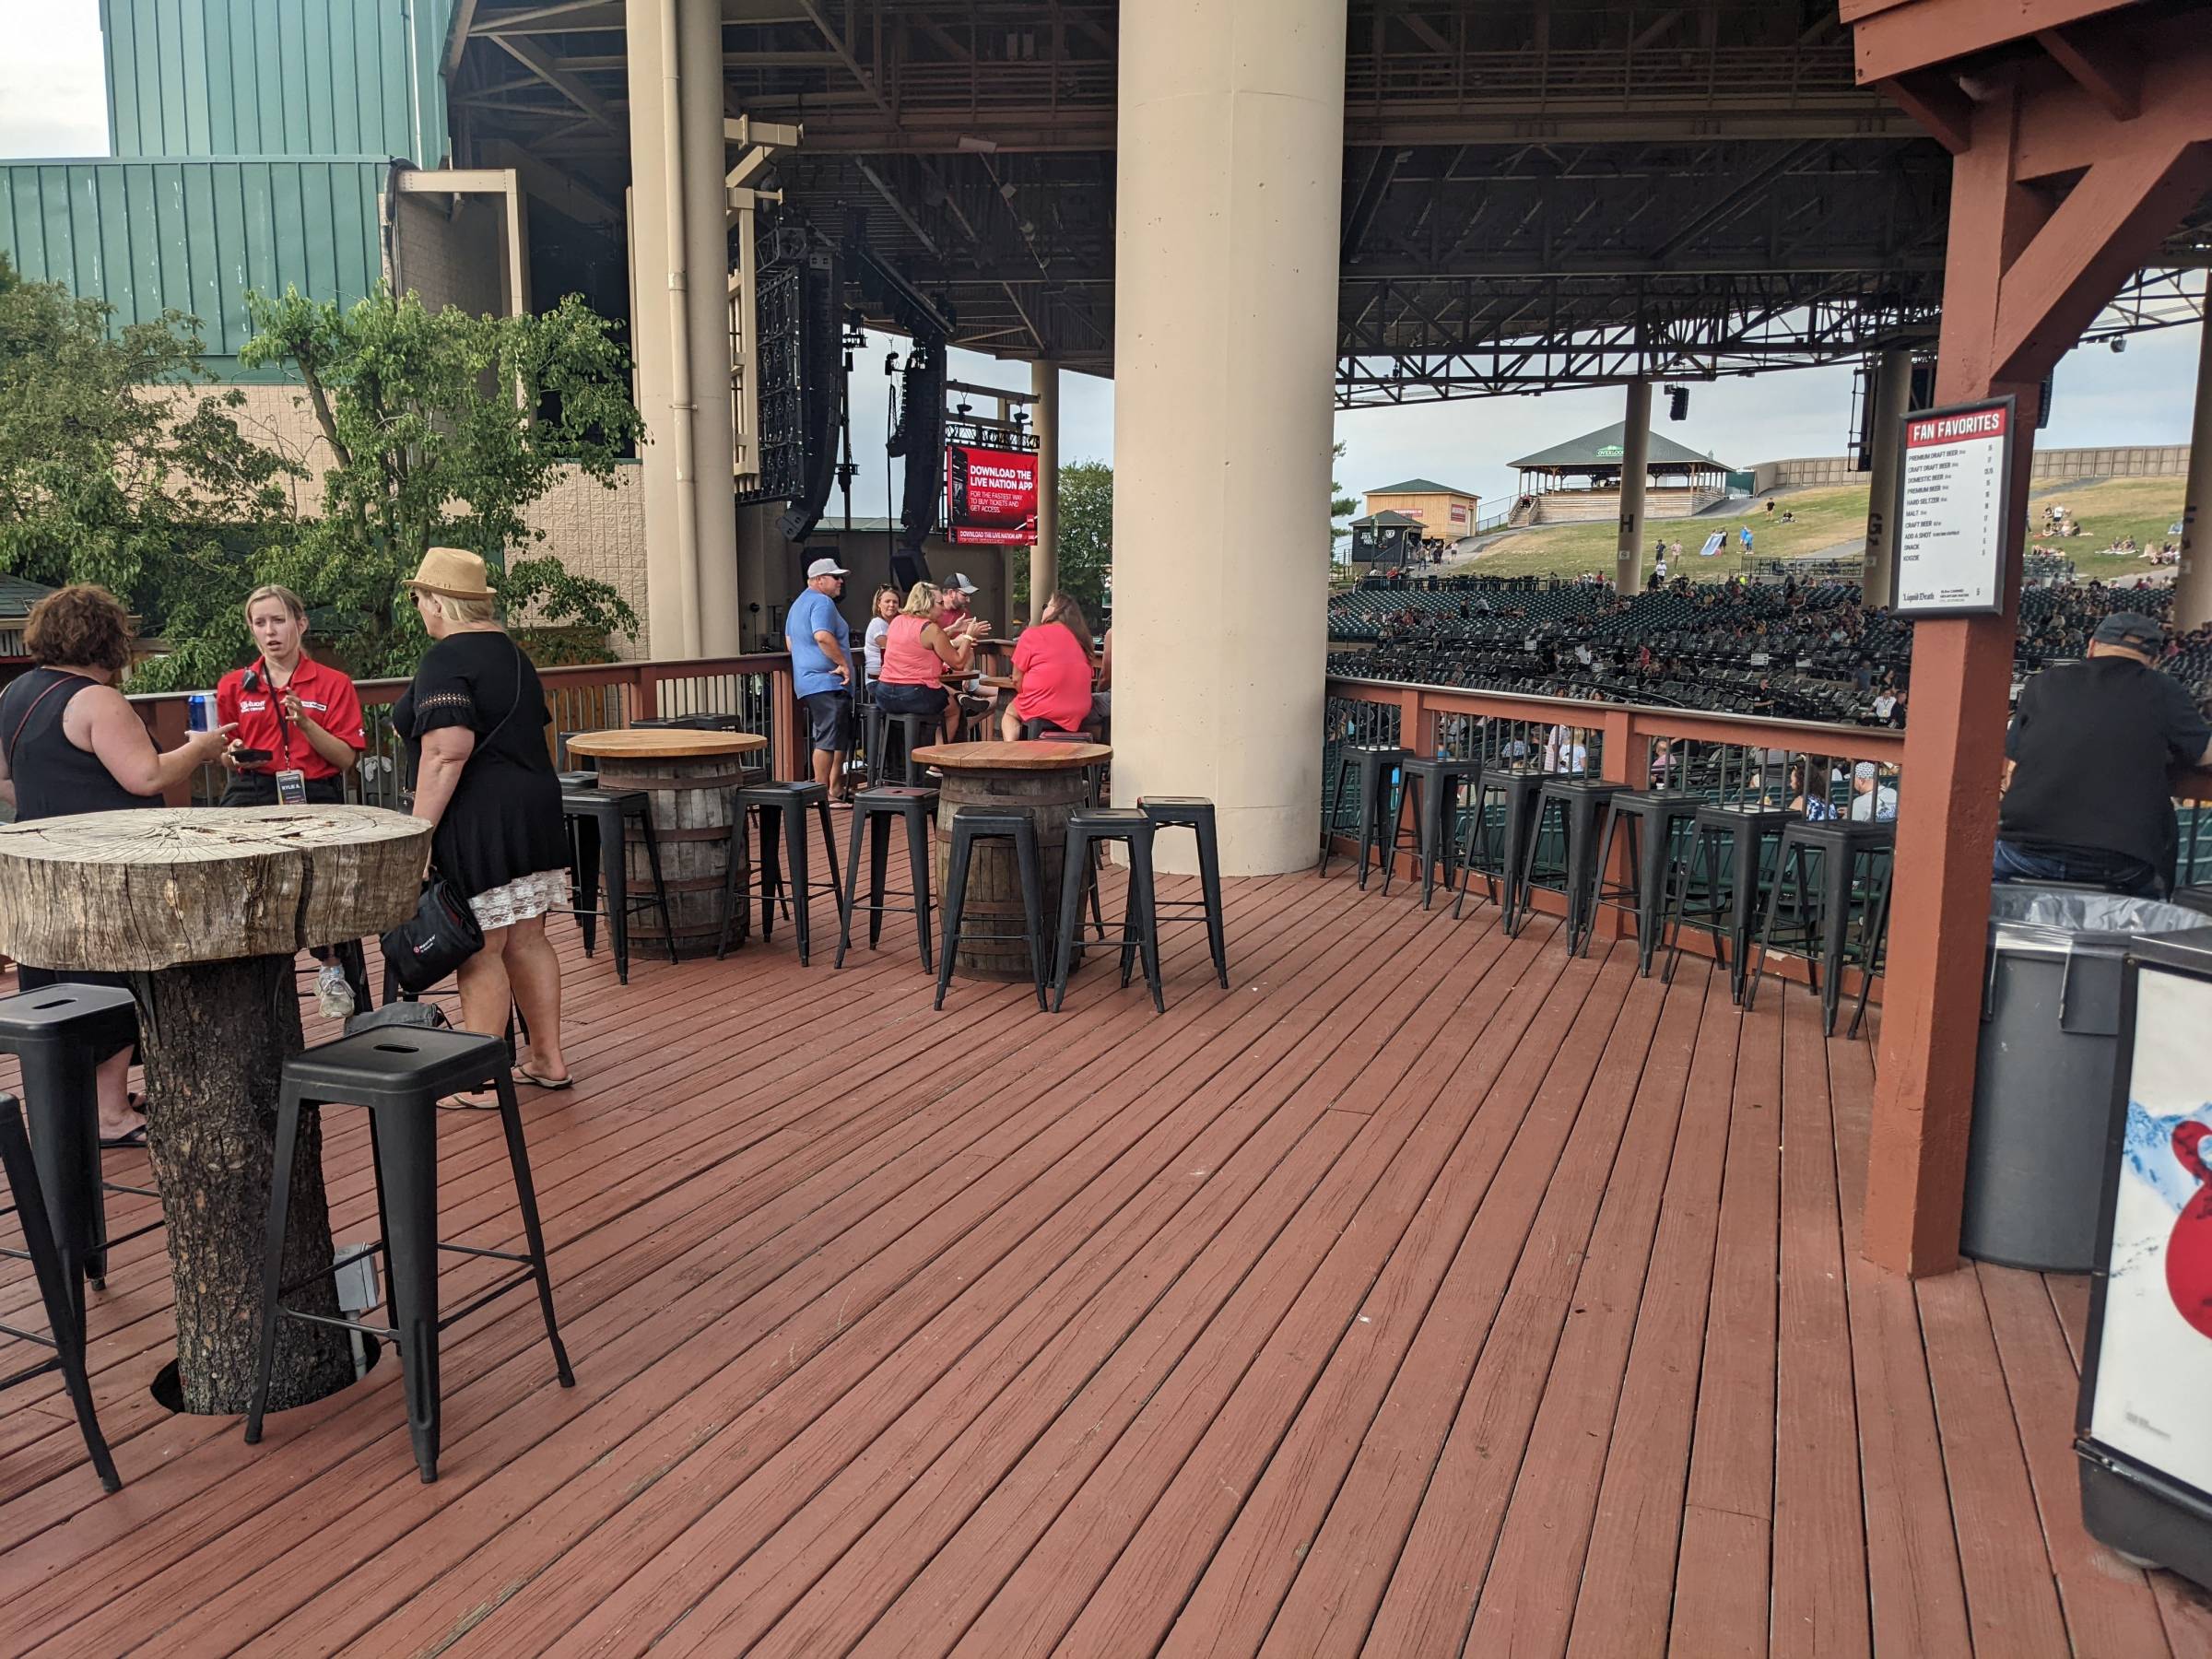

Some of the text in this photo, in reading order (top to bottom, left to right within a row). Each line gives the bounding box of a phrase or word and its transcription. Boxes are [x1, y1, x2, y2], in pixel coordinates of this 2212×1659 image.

[1913, 413, 2000, 441] FAN FAVORITES
[1909, 453, 1931, 462] PREMIUM
[1931, 451, 1946, 459] DRAFT
[971, 465, 1032, 479] DOWNLOAD THE
[1908, 465, 1923, 474] CRAFT
[1924, 464, 1938, 472] DRAFT
[971, 477, 1033, 490] LIVE NATION APP
[1908, 476, 1931, 484] DOMESTIC
[1930, 485, 1941, 493] BEER
[1620, 514, 1634, 533] H
[1869, 513, 1883, 535] G
[1903, 593, 1919, 603] Liquid
[1919, 592, 1935, 601] Death
